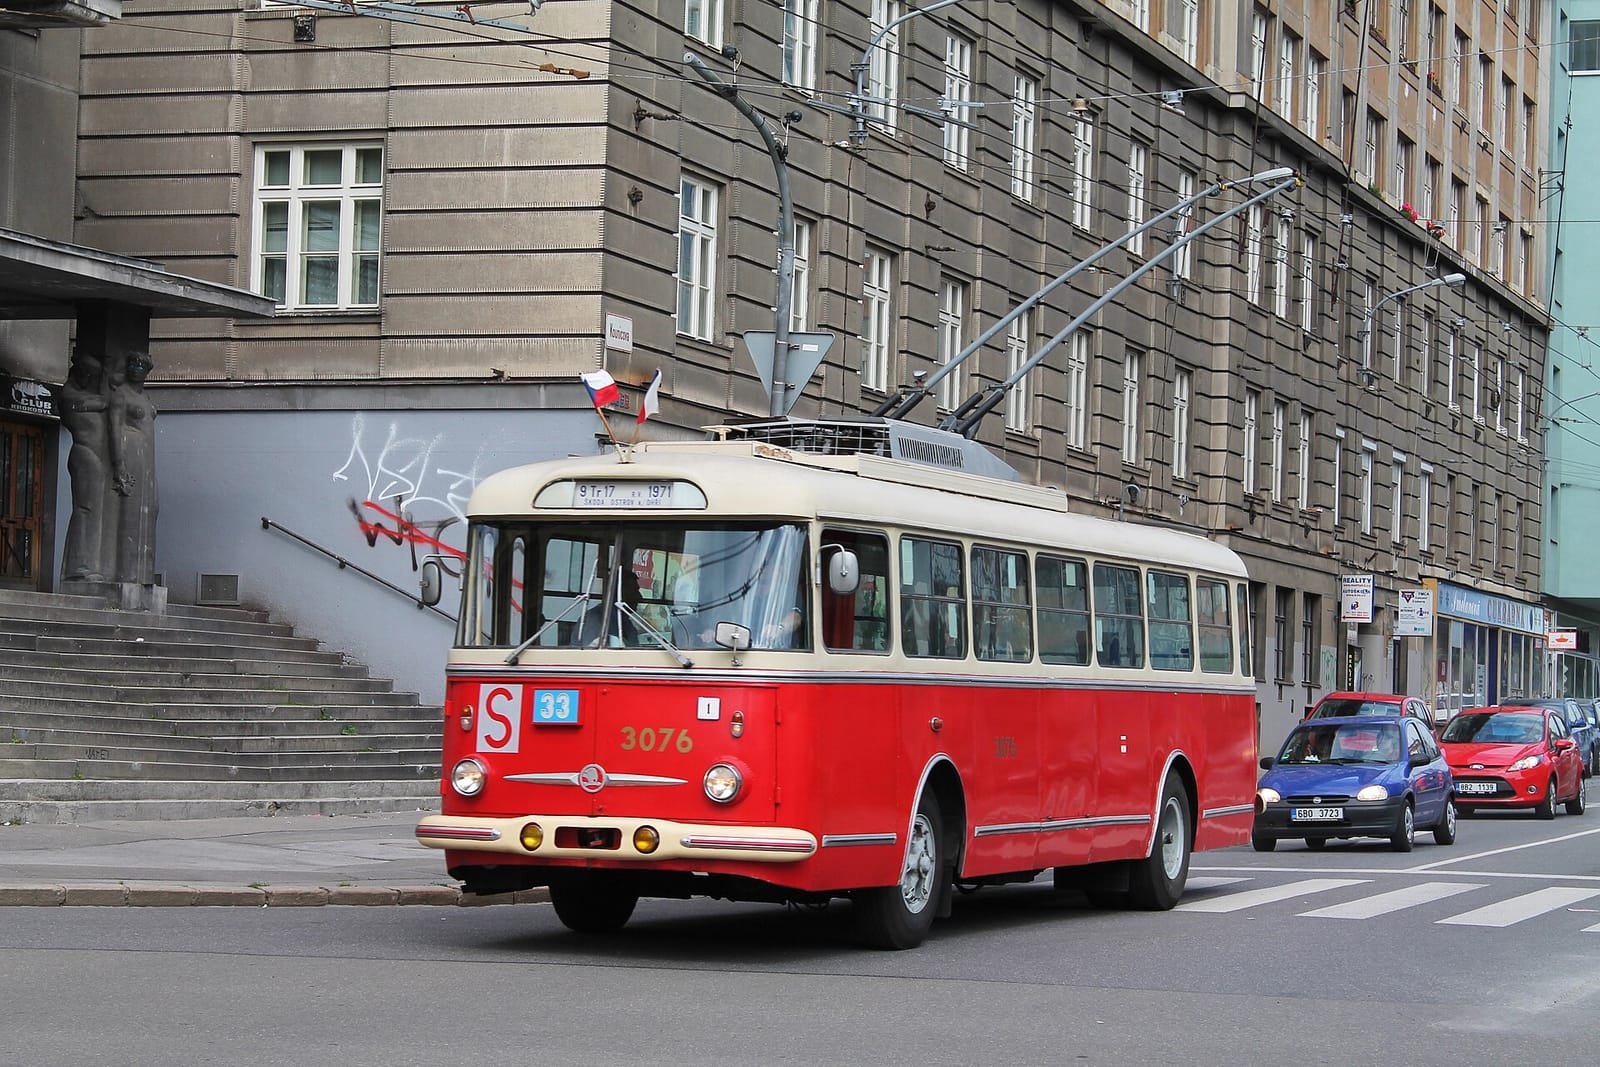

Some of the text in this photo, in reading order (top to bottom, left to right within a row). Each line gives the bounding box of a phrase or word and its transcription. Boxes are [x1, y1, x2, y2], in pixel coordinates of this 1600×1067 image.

[20, 398, 52, 409] CLUB
[580, 485, 587, 498] 9
[648, 485, 672, 498] 1971
[540, 692, 571, 719] 33
[484, 687, 513, 749] S
[620, 726, 694, 753] 3076
[1319, 809, 1339, 818] 3723
